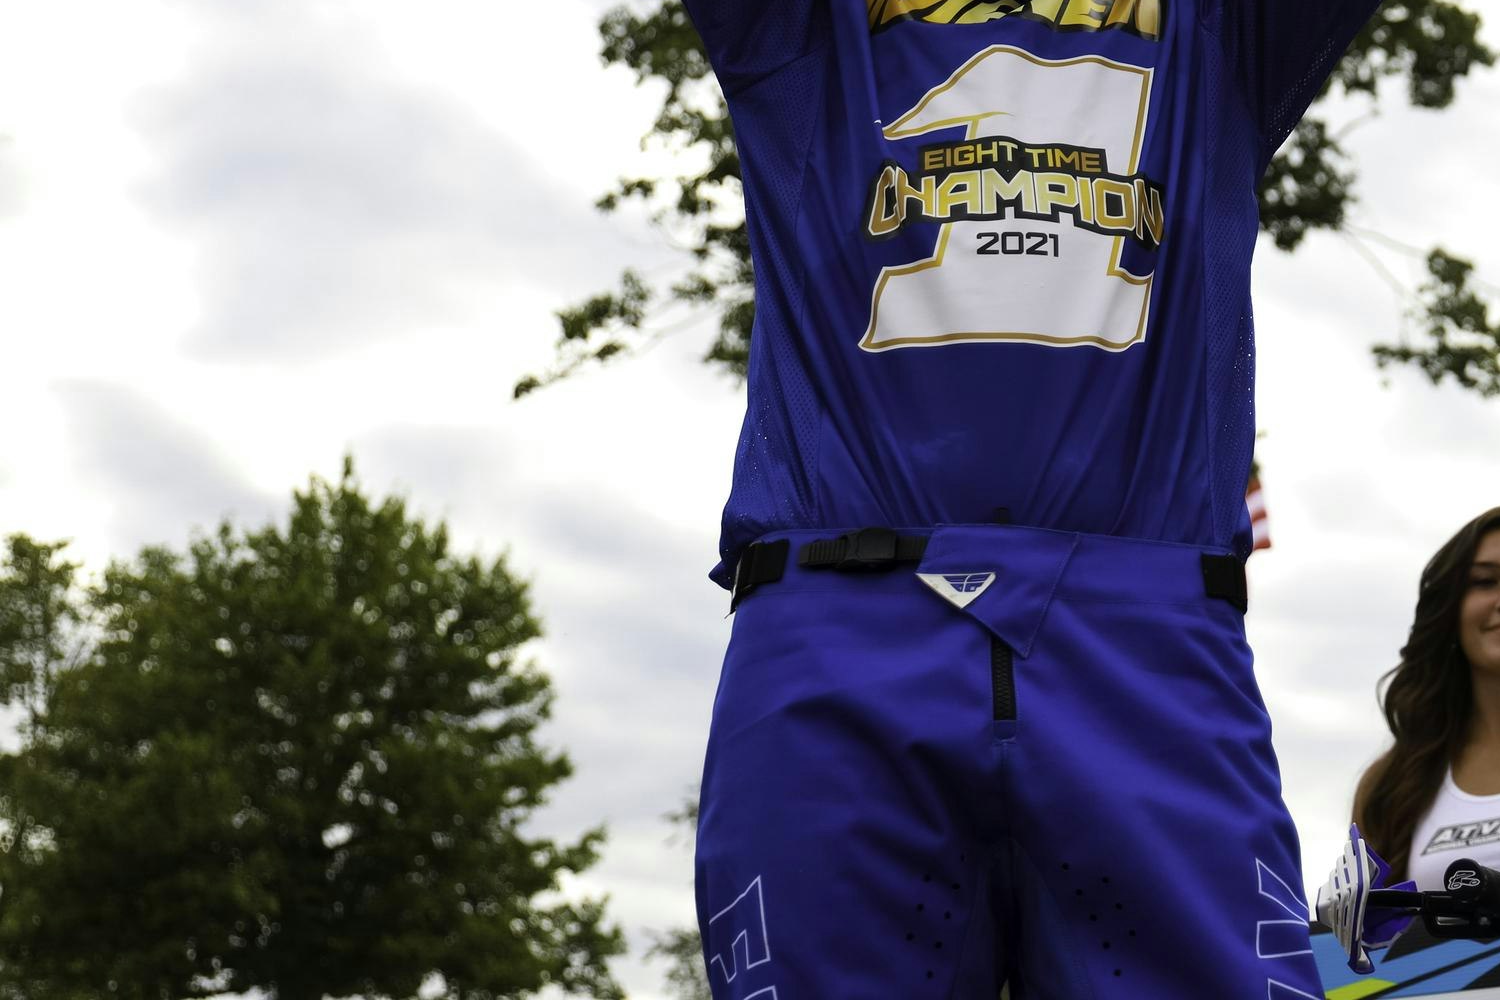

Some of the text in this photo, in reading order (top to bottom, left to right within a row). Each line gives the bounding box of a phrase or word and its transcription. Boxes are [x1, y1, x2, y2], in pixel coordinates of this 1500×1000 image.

[924, 141, 1101, 172] EIGHT TIME
[868, 165, 1164, 247] CHAMPION
[976, 231, 1060, 257] 2021
